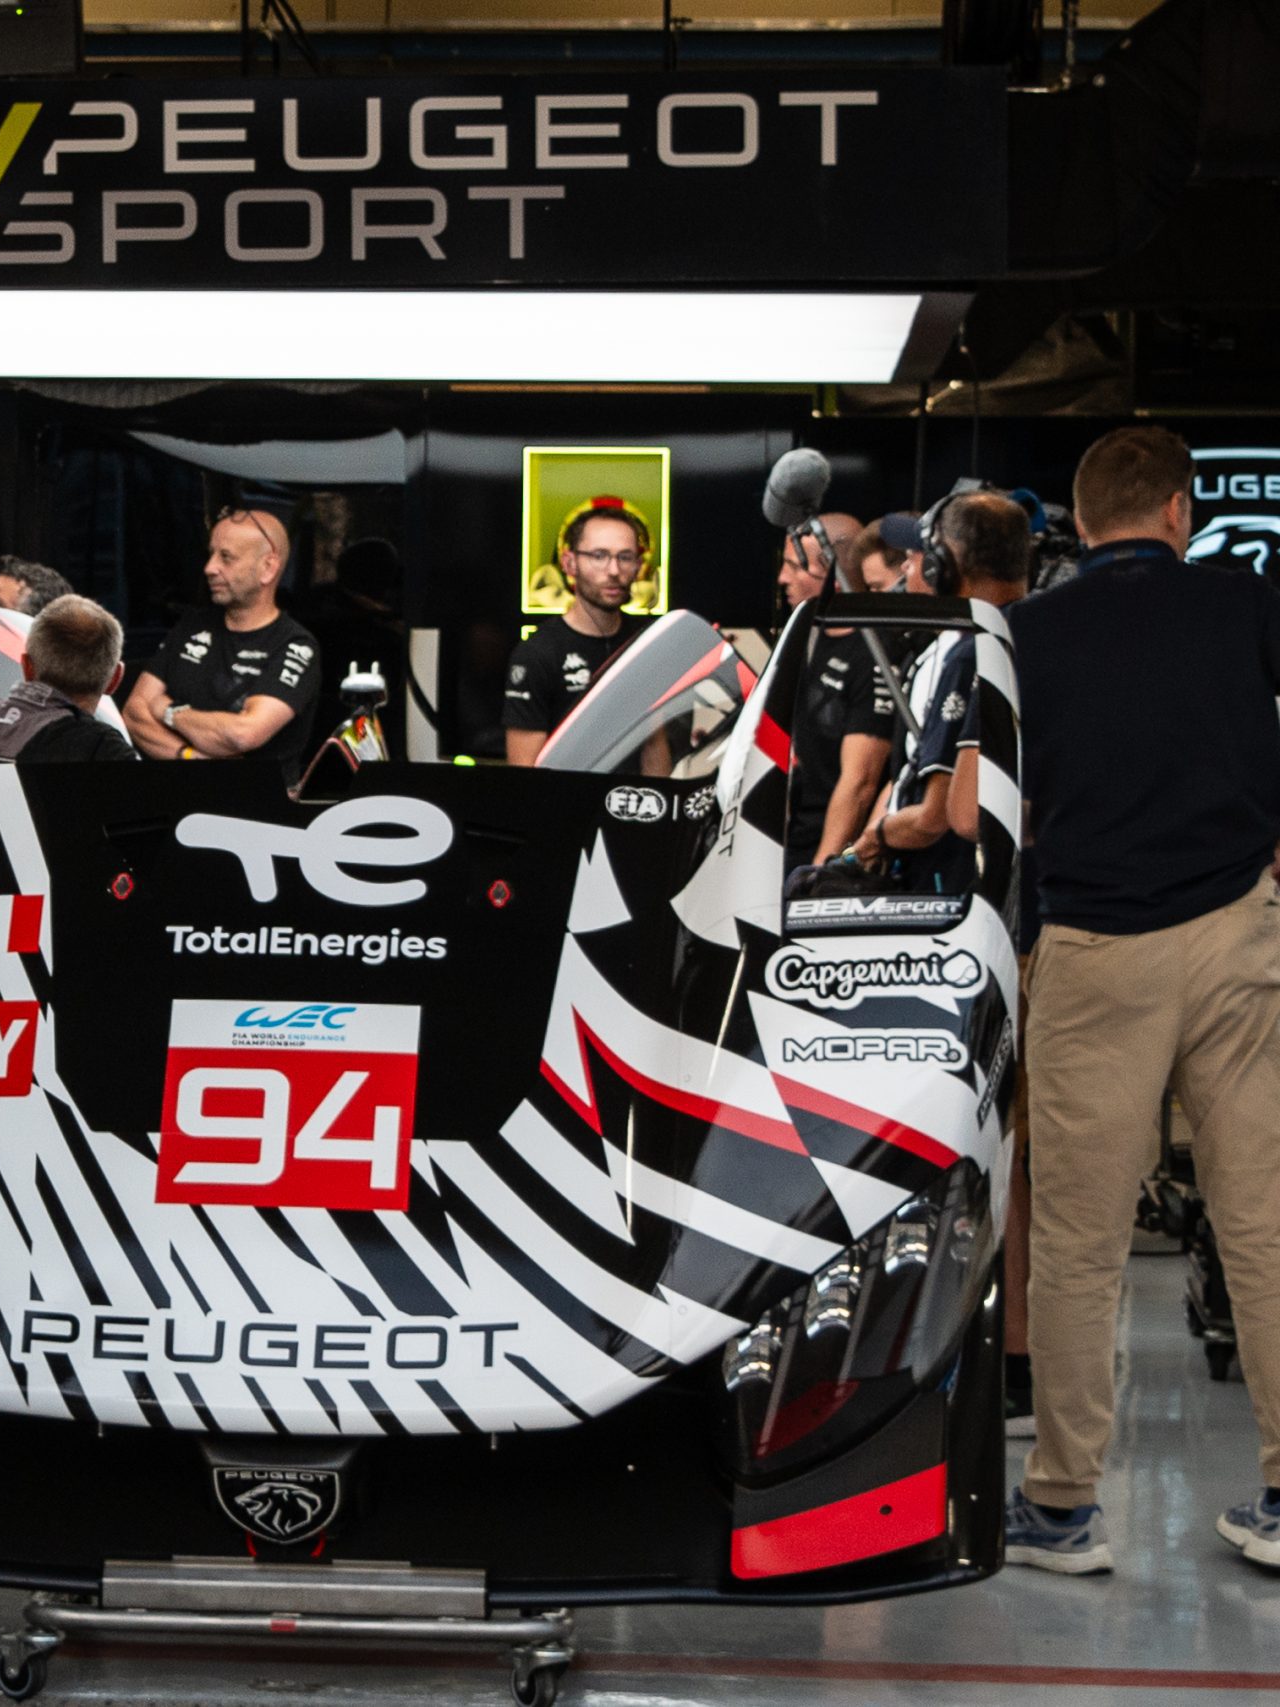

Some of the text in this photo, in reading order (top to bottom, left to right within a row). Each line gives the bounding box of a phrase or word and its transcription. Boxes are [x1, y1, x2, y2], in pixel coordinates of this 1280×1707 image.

[43, 91, 878, 175] PEUGEOT
[166, 926, 447, 965] TotalEnergies
[778, 953, 943, 998] Capgemini
[234, 1004, 357, 1030] WEC
[231, 1032, 347, 1043] FIA WORLD ENDURANCE
[231, 1039, 306, 1047] CHAMPIONSHIP
[172, 1067, 402, 1190] 94
[21, 1310, 519, 1370] PEUGEOT
[224, 1471, 328, 1483] PEUGEOT
